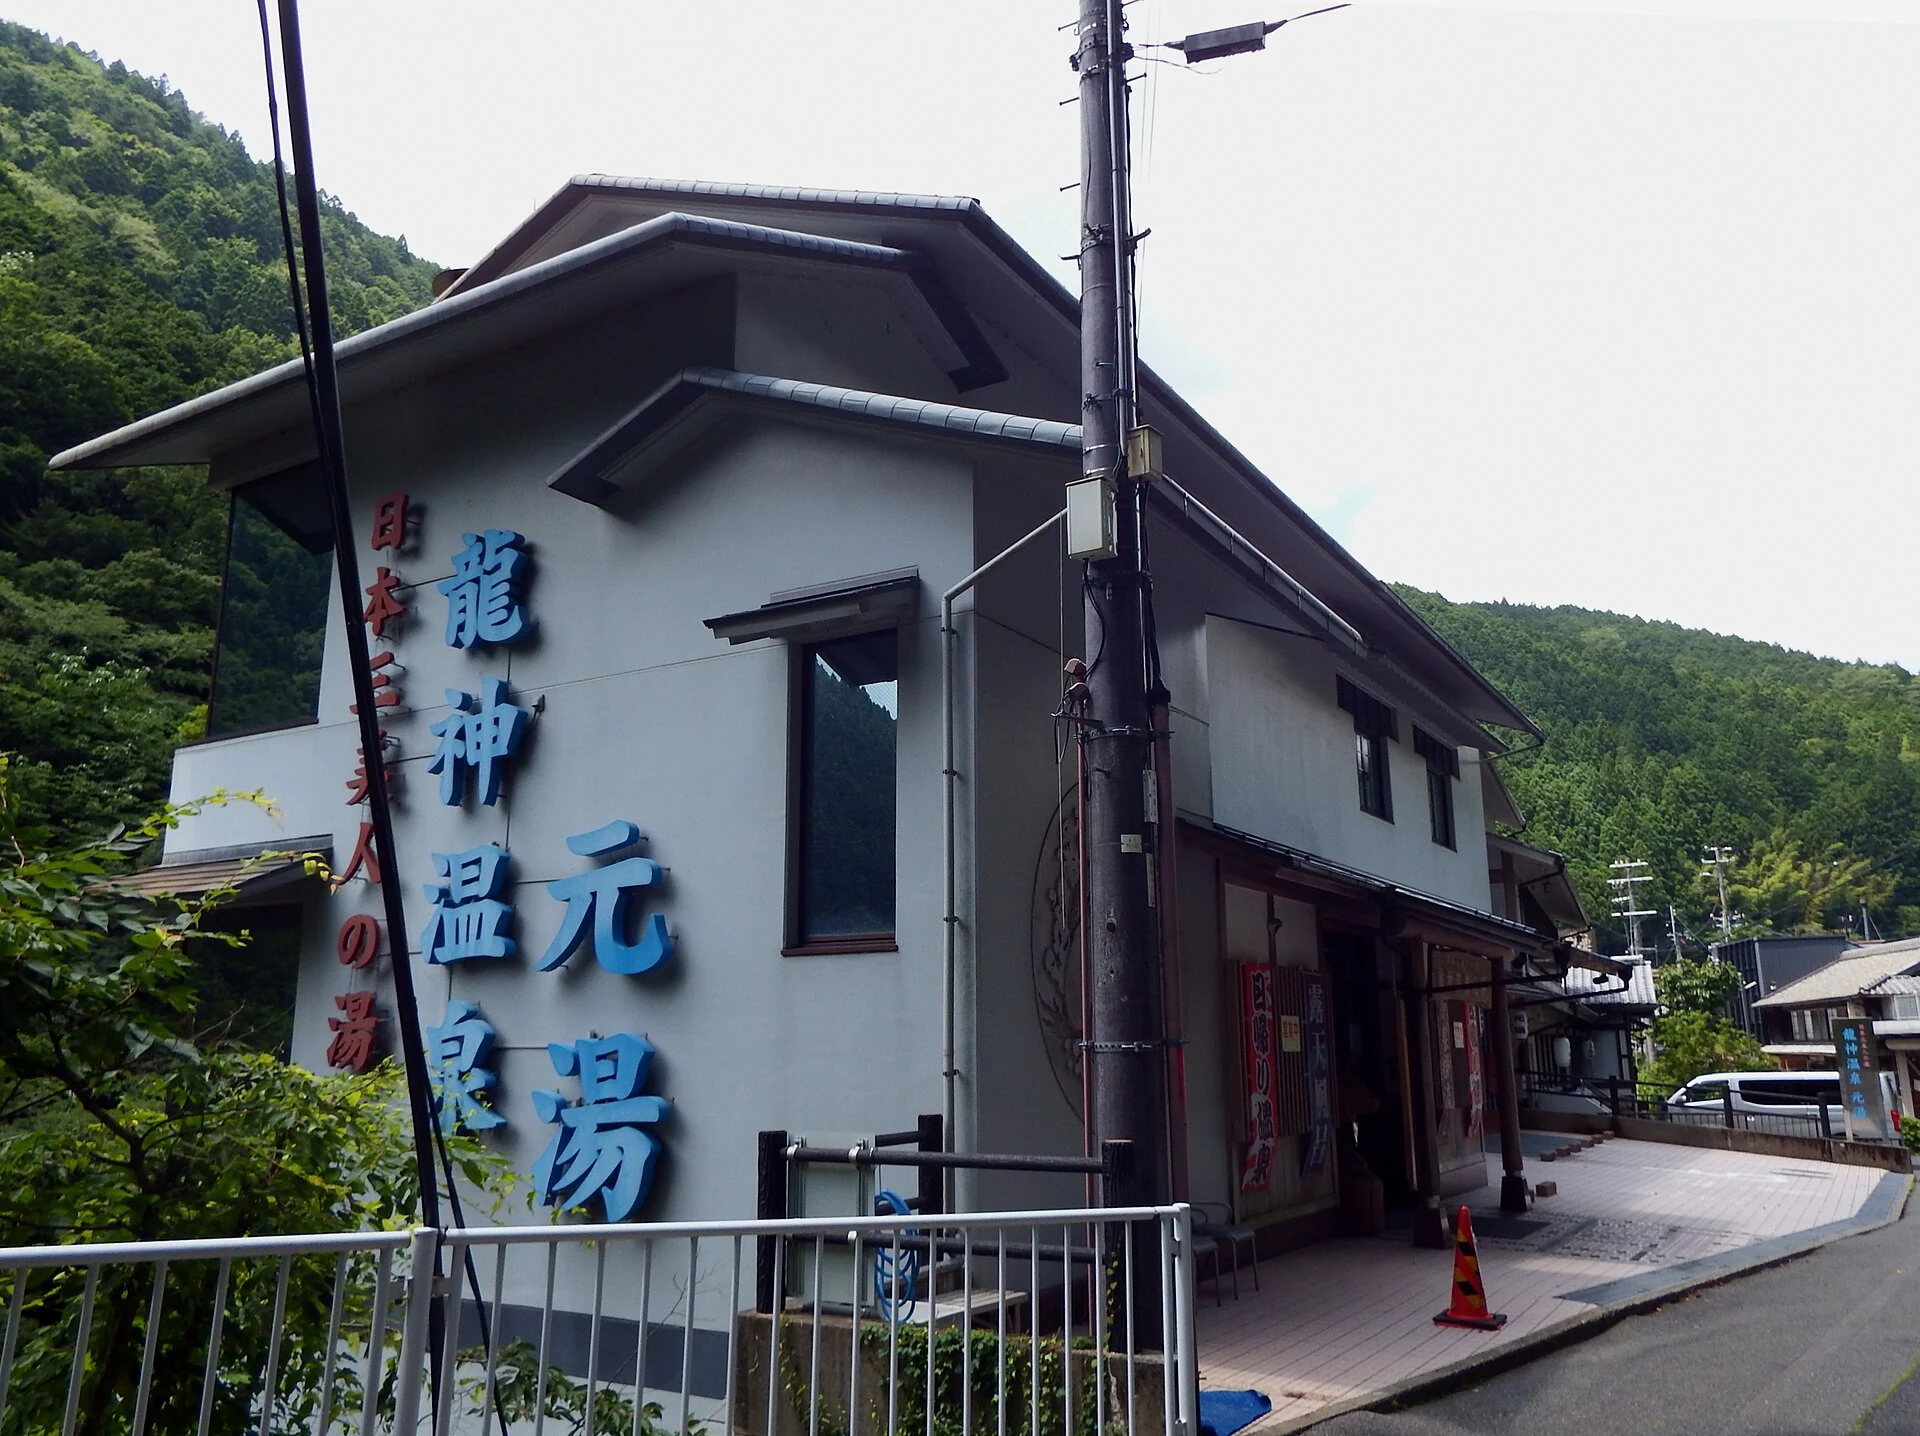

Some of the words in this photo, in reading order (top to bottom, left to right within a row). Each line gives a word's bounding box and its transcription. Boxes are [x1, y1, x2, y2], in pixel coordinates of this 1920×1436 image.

[421, 529, 528, 1136] 龍神温泉
[531, 820, 674, 1222] 元湯
[1308, 983, 1328, 1165] 露天風呂
